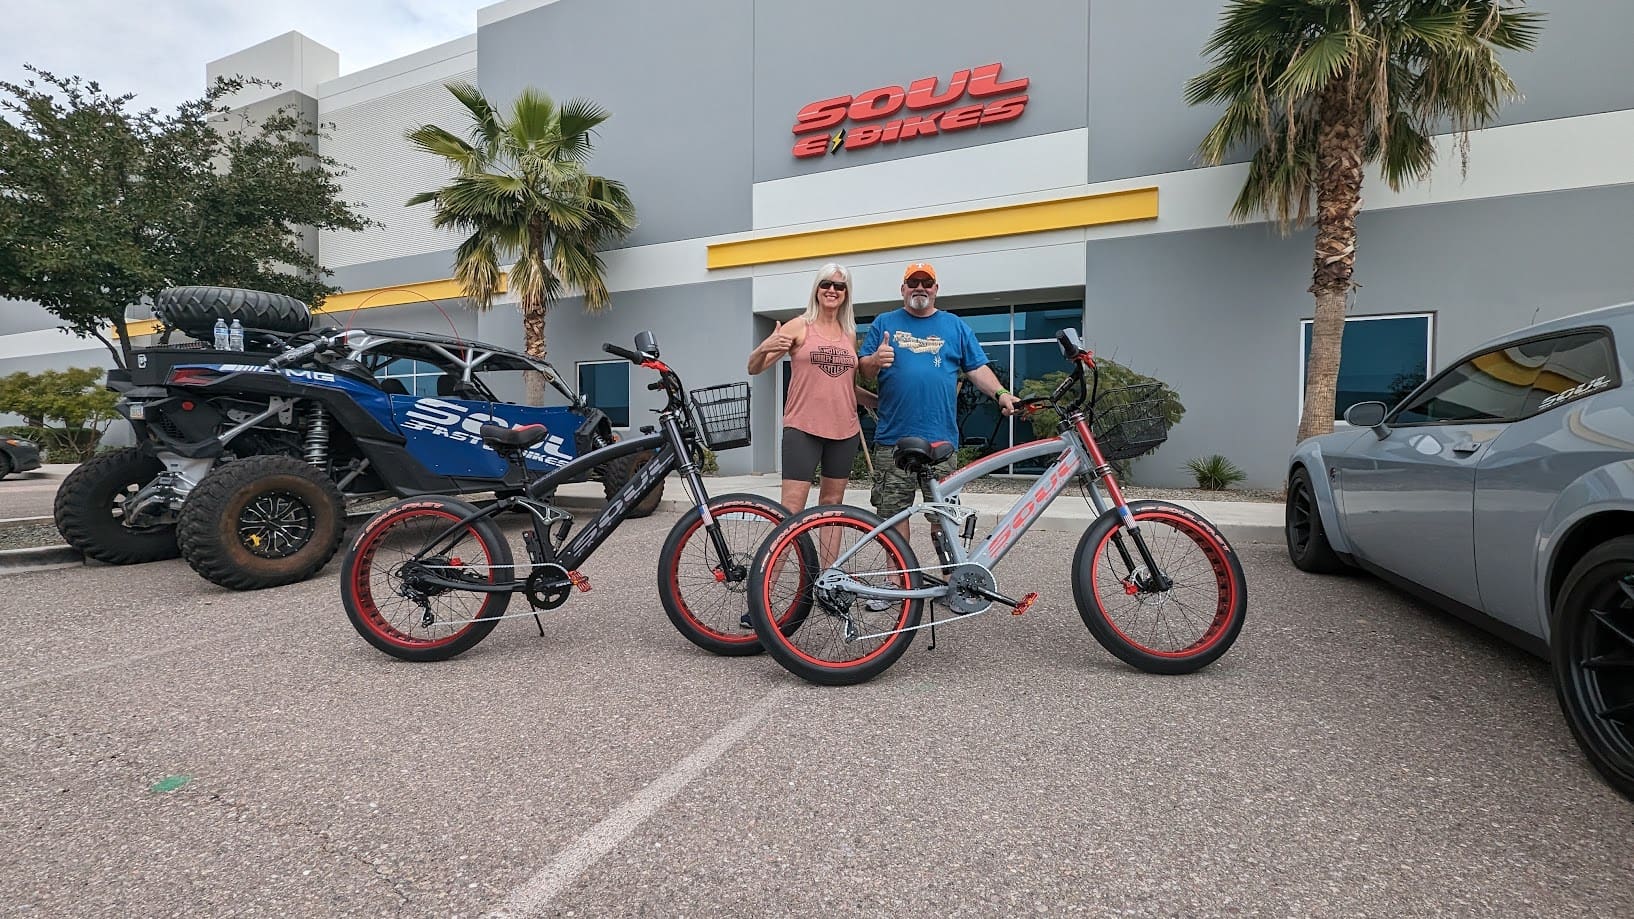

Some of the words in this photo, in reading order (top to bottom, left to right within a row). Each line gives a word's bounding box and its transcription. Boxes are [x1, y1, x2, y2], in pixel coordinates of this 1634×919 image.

[792, 62, 1029, 135] SOUL
[260, 364, 335, 382] AMG
[1538, 375, 1611, 408] SOUL
[402, 419, 483, 446] FAST
[573, 453, 675, 557] SOUL
[988, 456, 1082, 558] SOUL
